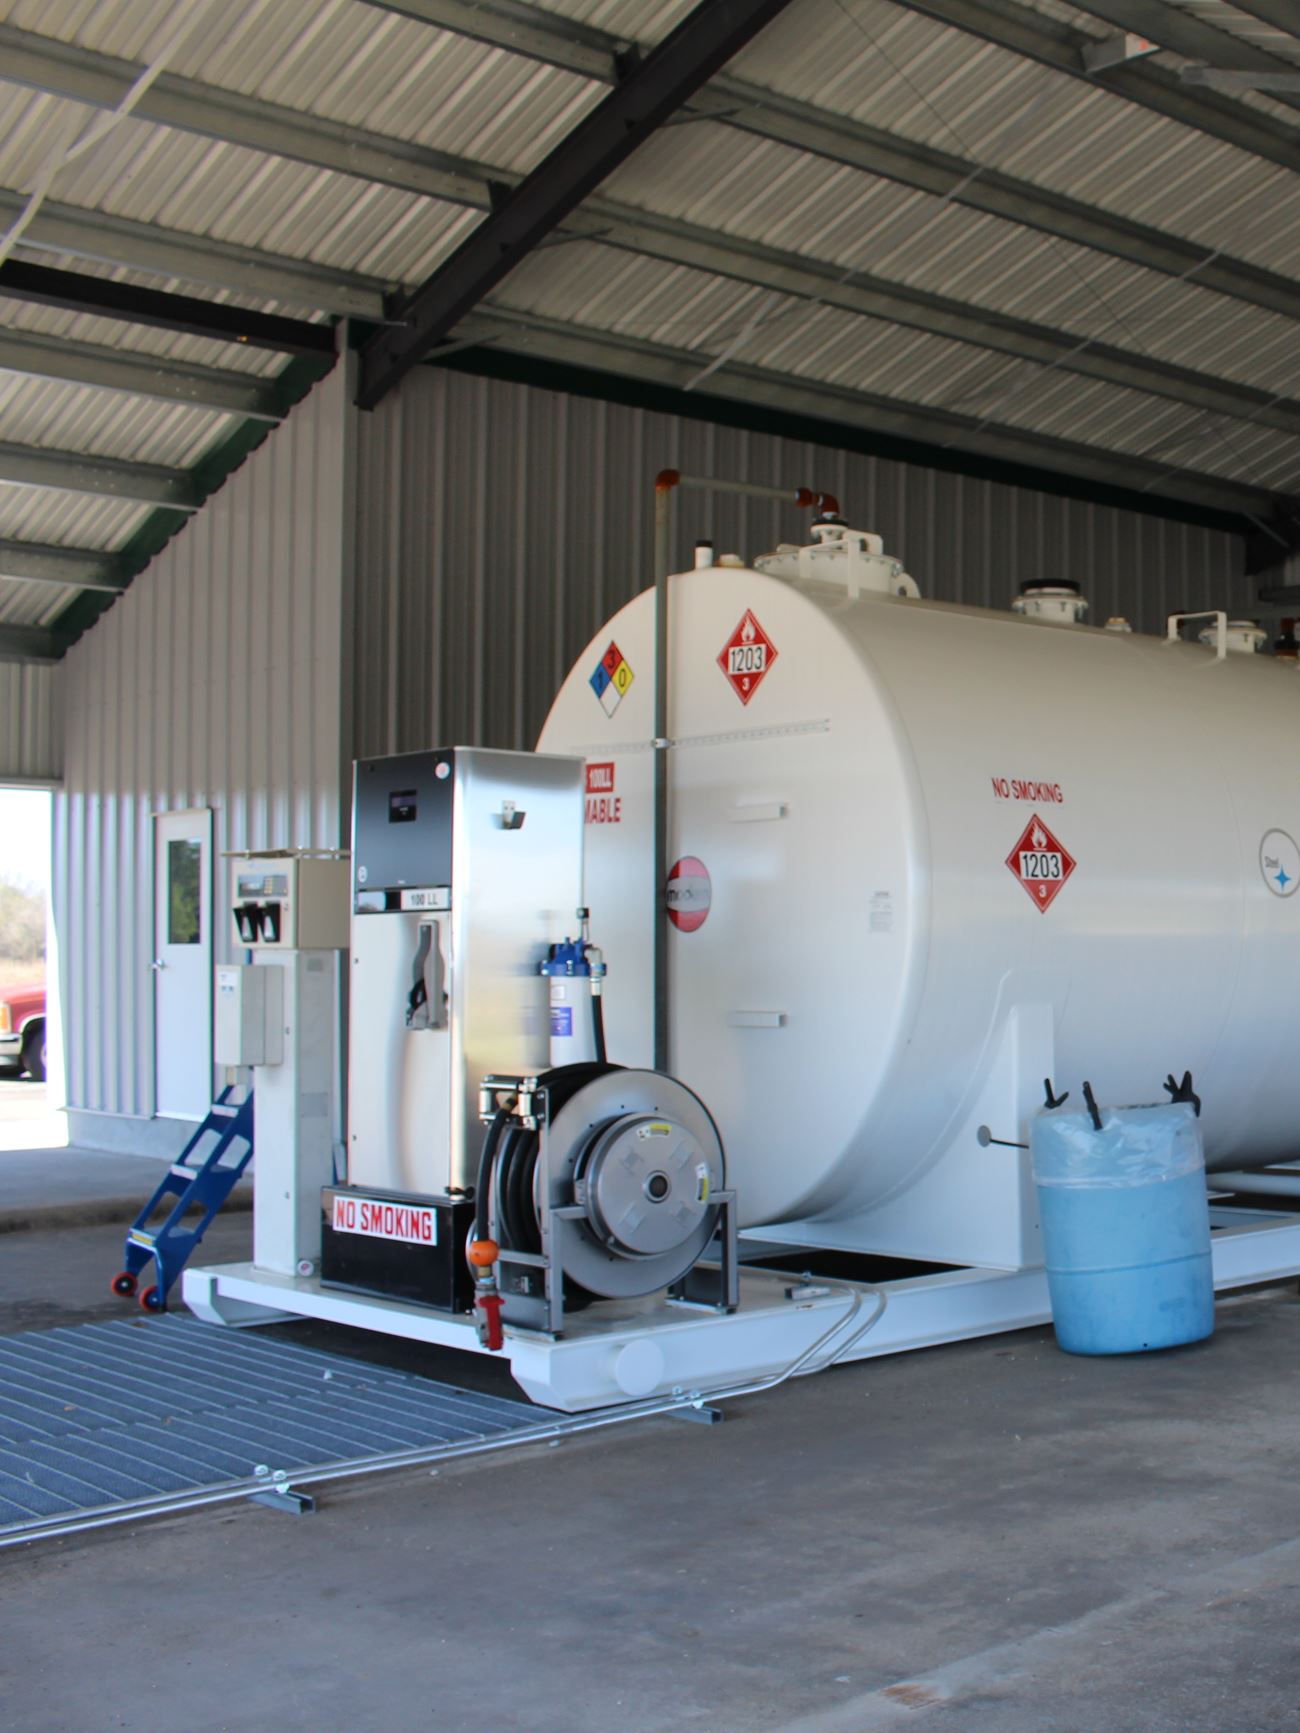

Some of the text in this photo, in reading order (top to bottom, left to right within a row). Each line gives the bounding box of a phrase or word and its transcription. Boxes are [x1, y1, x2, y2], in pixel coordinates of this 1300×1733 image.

[731, 645, 763, 673] 1203
[742, 677, 751, 691] 3
[991, 777, 1064, 803] NO SMOKING
[1022, 853, 1061, 878] 1203
[1038, 884, 1048, 898] 3
[336, 1200, 432, 1241] NO SMOKING
